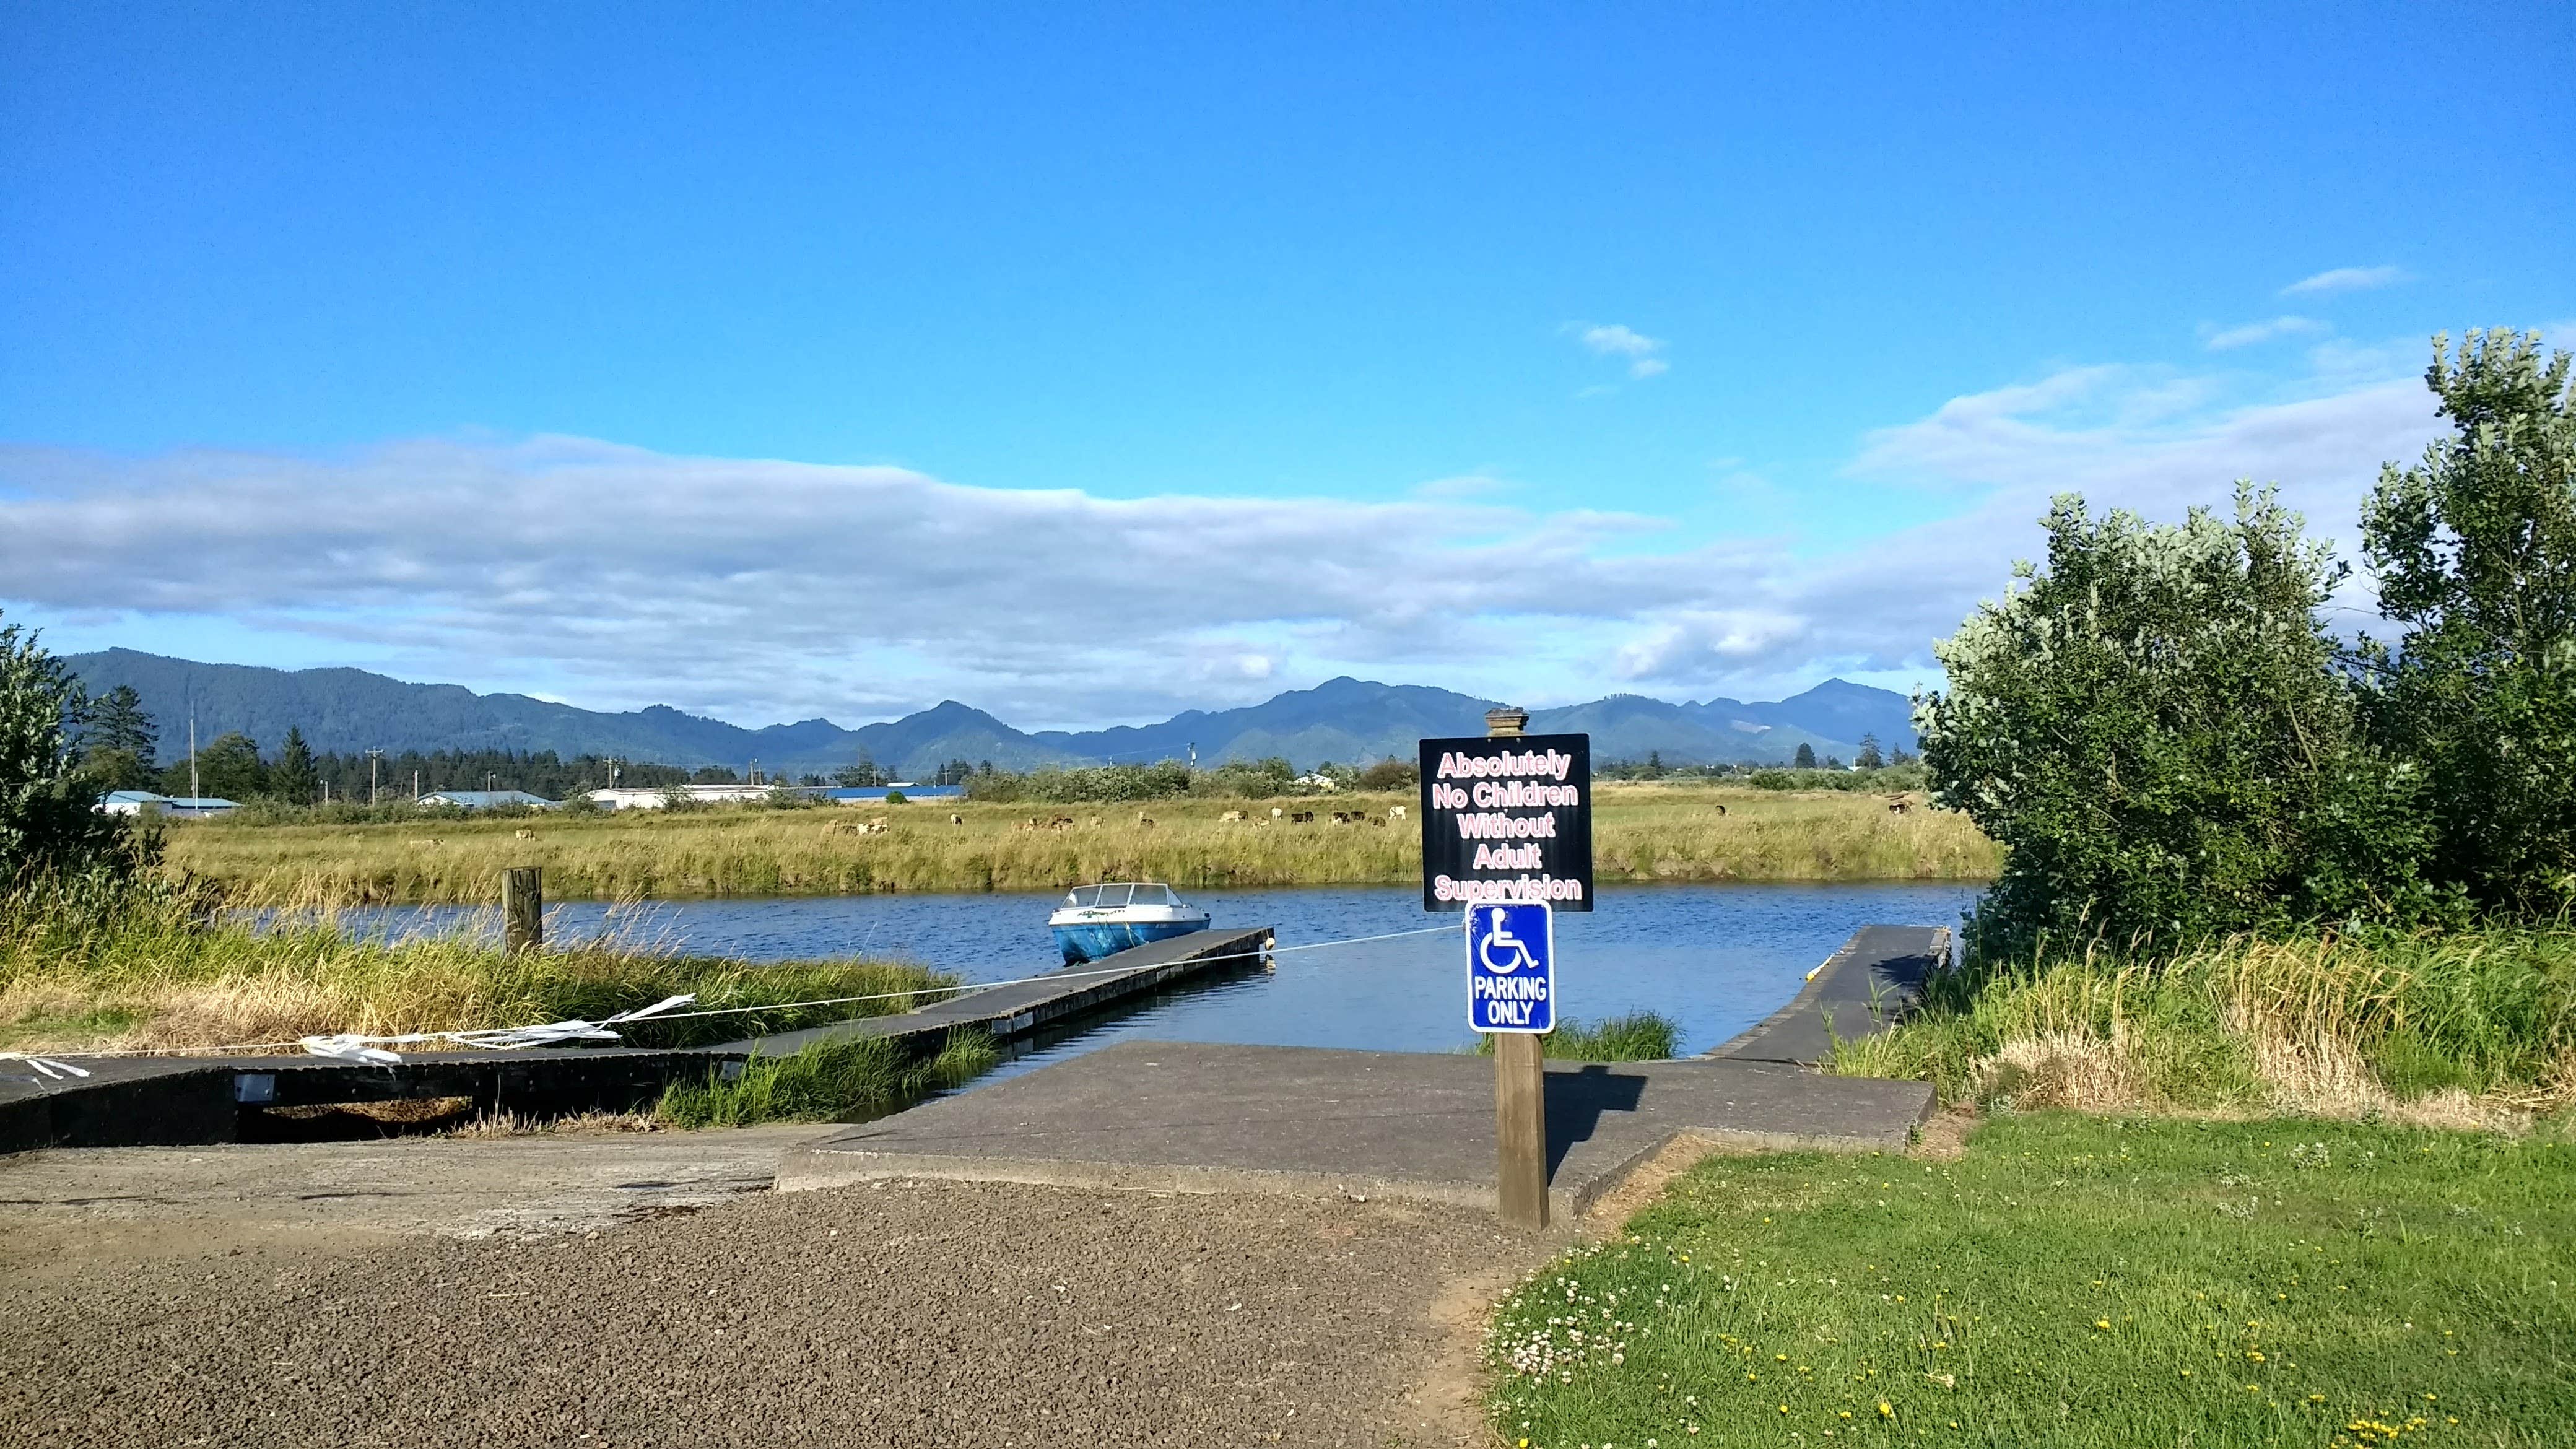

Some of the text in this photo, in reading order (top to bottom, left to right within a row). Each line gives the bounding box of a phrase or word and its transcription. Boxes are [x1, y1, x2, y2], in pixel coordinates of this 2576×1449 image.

[1437, 749, 1571, 780] Absolutely
[1432, 781, 1578, 809] No Children
[1456, 812, 1556, 839] Without
[1473, 843, 1542, 869] Adult
[1434, 874, 1582, 902] Supervision
[1474, 976, 1547, 1001] PARKING
[1487, 1000, 1534, 1025] ONLY
